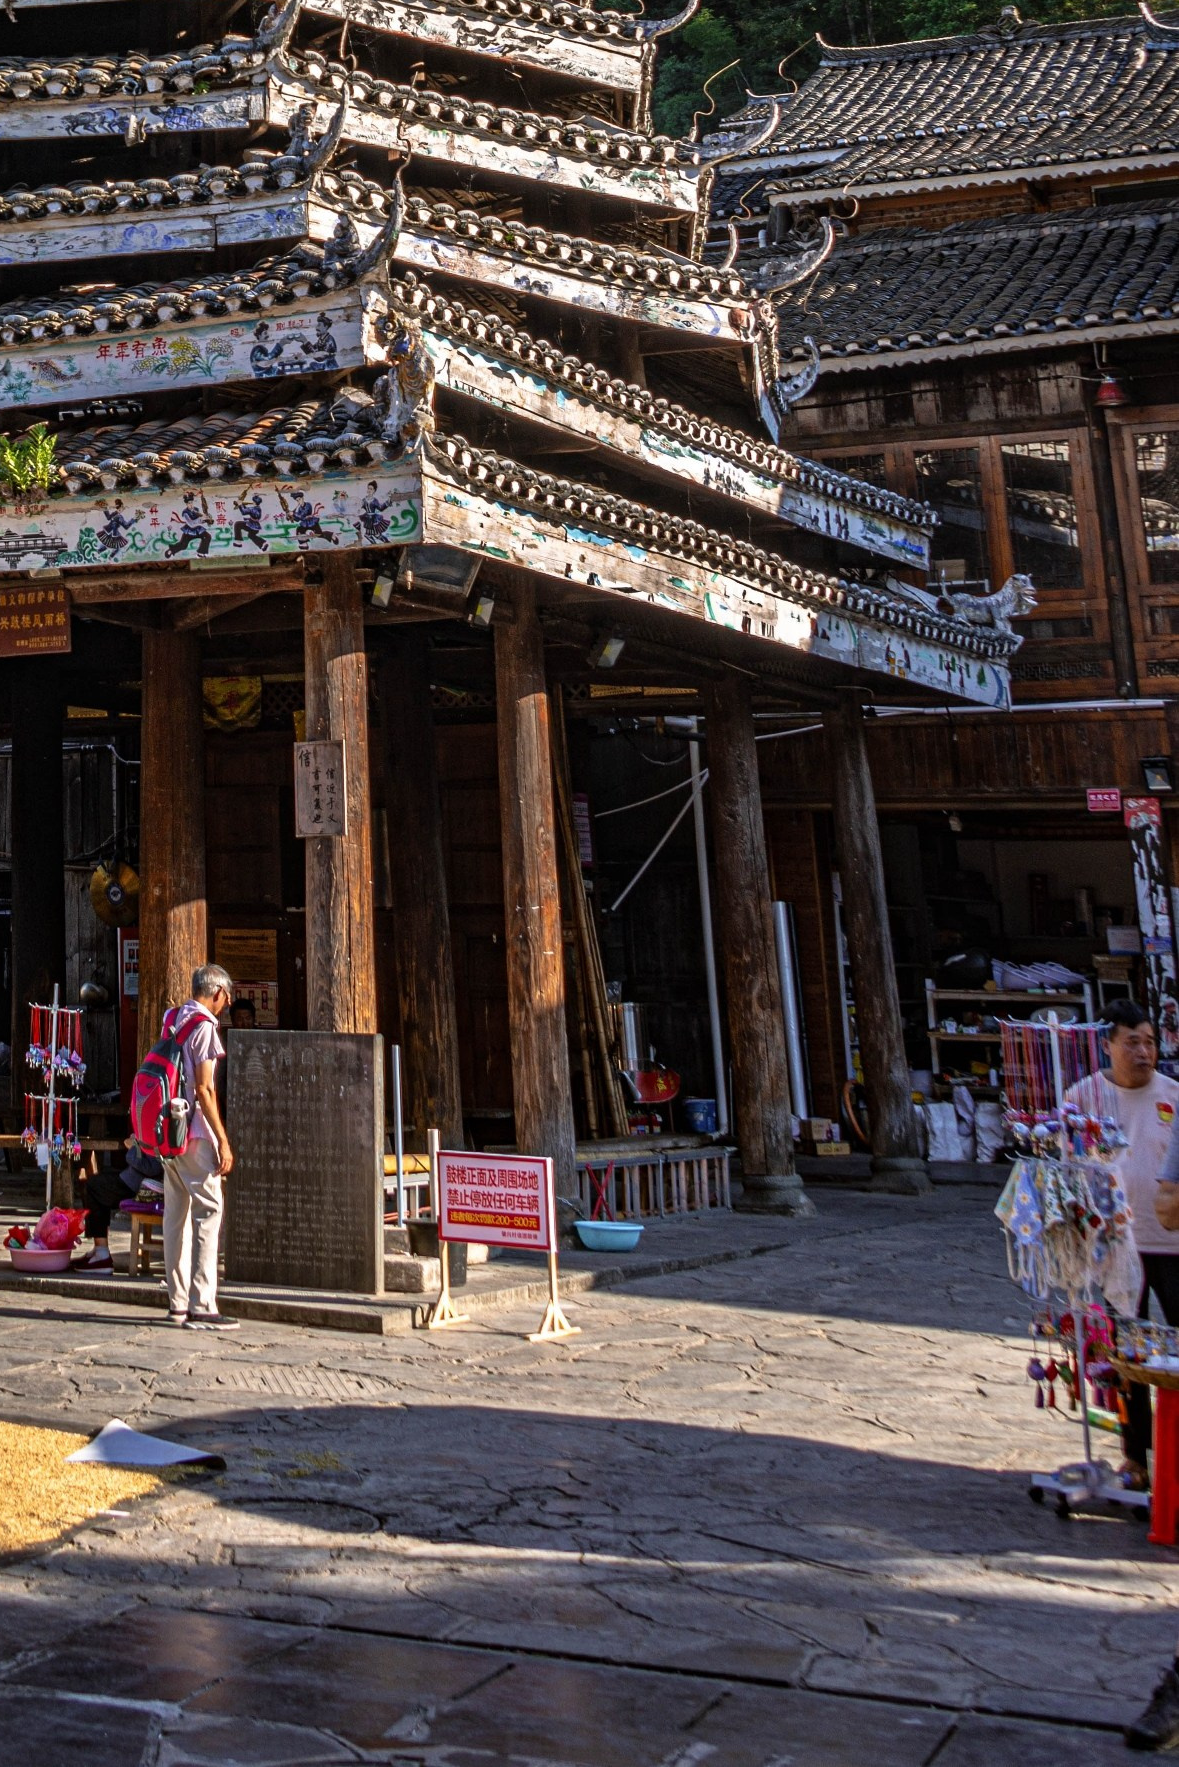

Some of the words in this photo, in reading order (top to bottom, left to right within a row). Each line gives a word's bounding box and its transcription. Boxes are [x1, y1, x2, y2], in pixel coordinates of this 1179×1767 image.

[298, 749, 312, 768] 信
[446, 1164, 539, 1191] 鼓楼正面及周围场地
[447, 1188, 539, 1213] 禁止停放任何车辆
